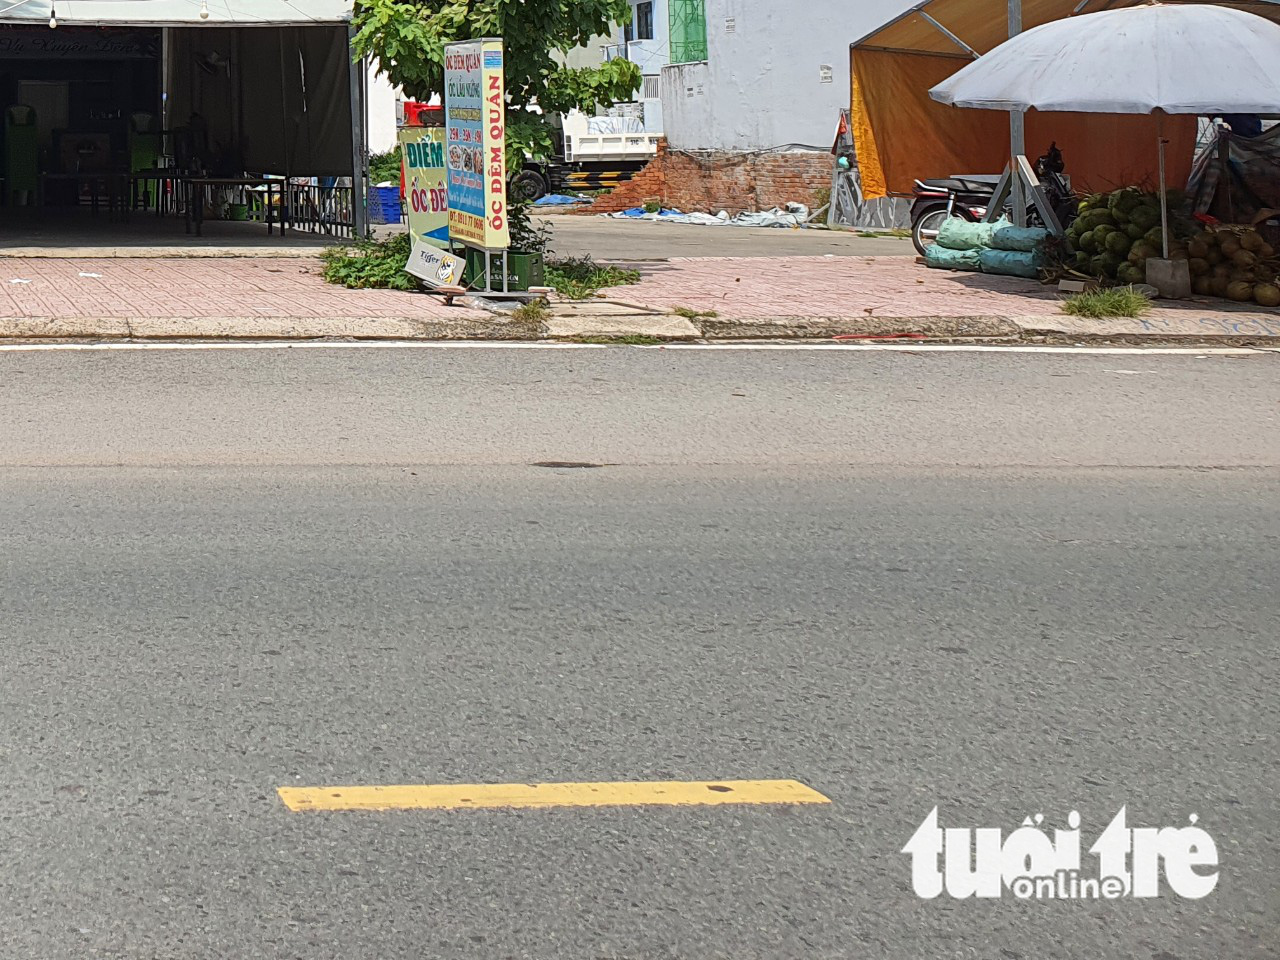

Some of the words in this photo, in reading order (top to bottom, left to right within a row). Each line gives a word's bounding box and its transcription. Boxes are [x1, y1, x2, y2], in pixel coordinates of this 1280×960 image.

[486, 75, 504, 140] QUÁN
[406, 134, 444, 168] ĐIỂM
[411, 176, 428, 213] ỐC
[429, 180, 448, 212] ĐÊ
[486, 200, 503, 230] ỐC
[420, 250, 440, 264] Tiger
